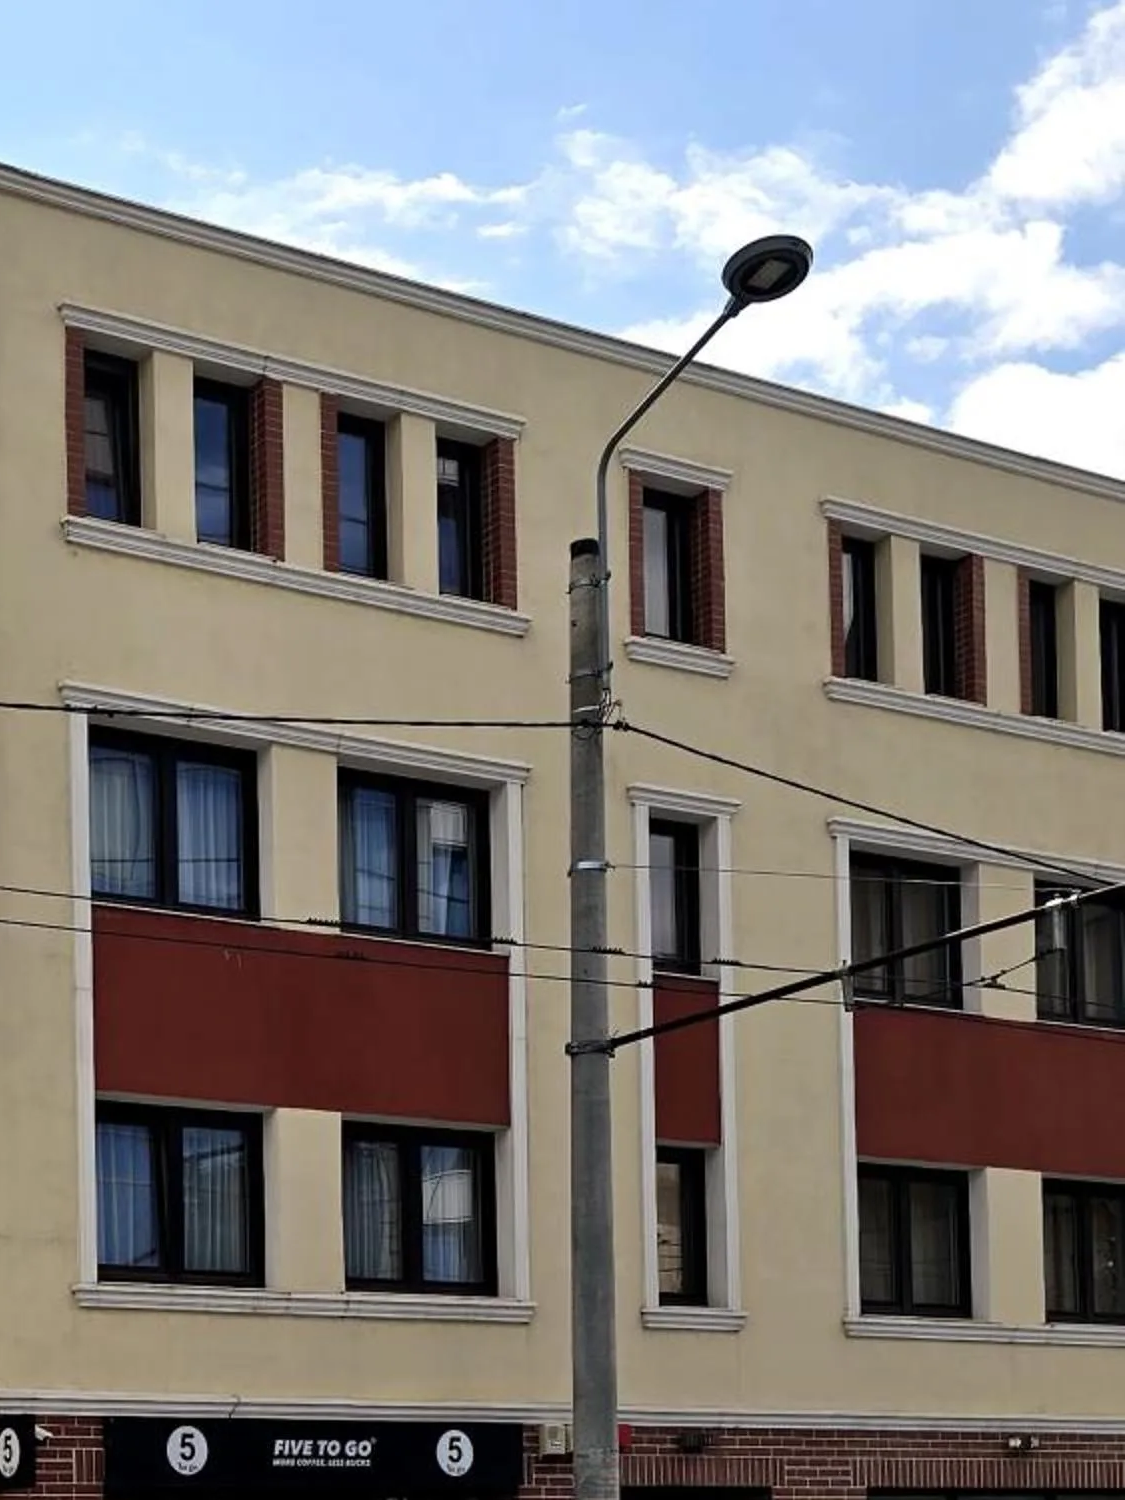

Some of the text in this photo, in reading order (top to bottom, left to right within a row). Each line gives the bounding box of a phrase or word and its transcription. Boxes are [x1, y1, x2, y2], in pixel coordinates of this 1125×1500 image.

[3, 1434, 12, 1464] 5
[180, 1432, 196, 1461] 5
[274, 1439, 372, 1457] FIVE TO GO
[448, 1436, 463, 1463] 5
